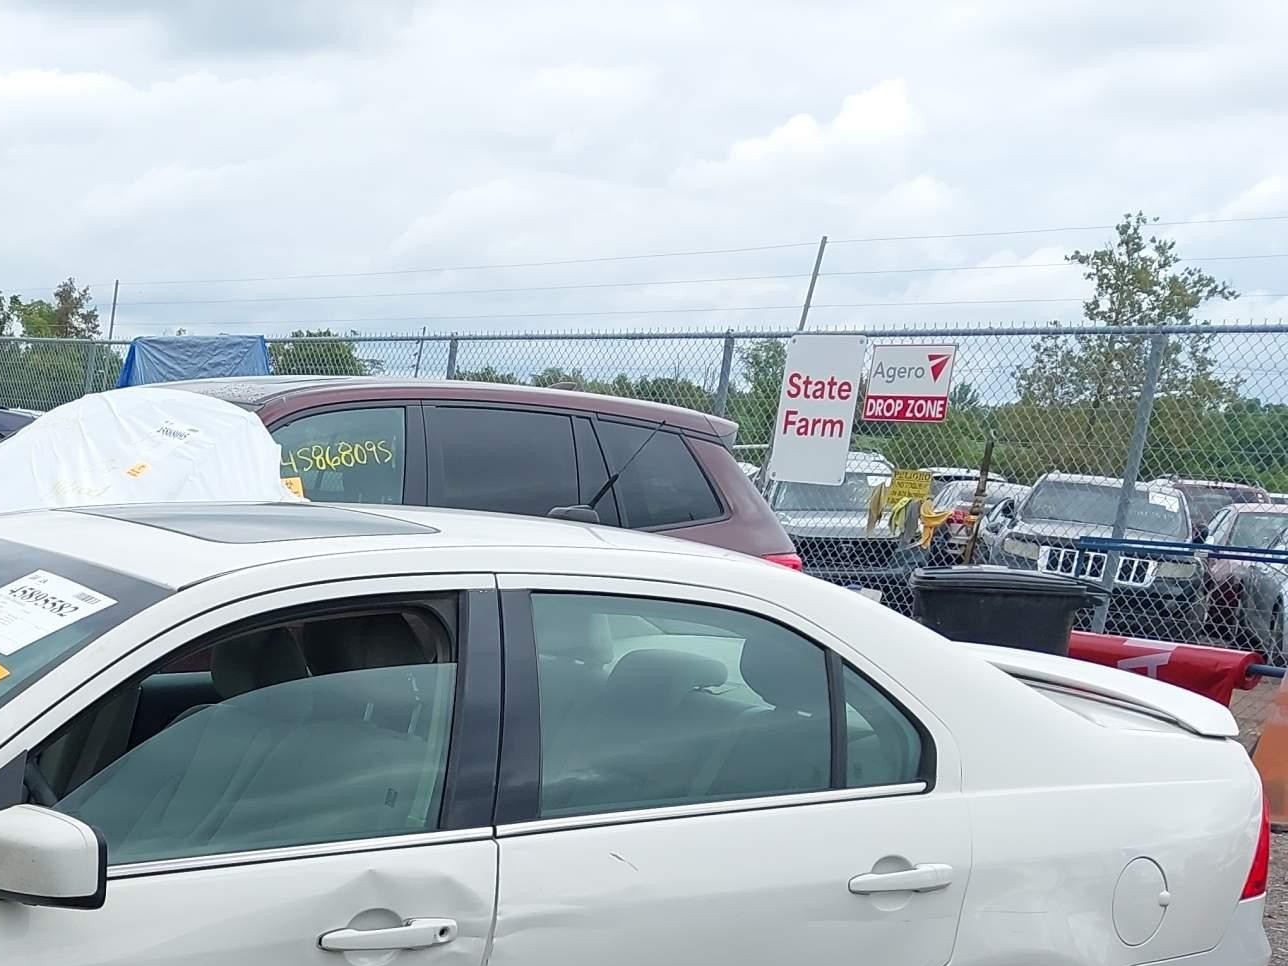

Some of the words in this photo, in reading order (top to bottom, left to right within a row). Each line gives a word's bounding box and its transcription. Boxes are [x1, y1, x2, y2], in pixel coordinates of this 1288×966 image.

[786, 373, 852, 401] State
[873, 362, 925, 384] Agero
[866, 398, 905, 418] DROP
[905, 399, 945, 419] ZONE
[782, 410, 845, 438] Farm
[280, 440, 393, 473] 45868095
[9, 585, 79, 617] 45895582
